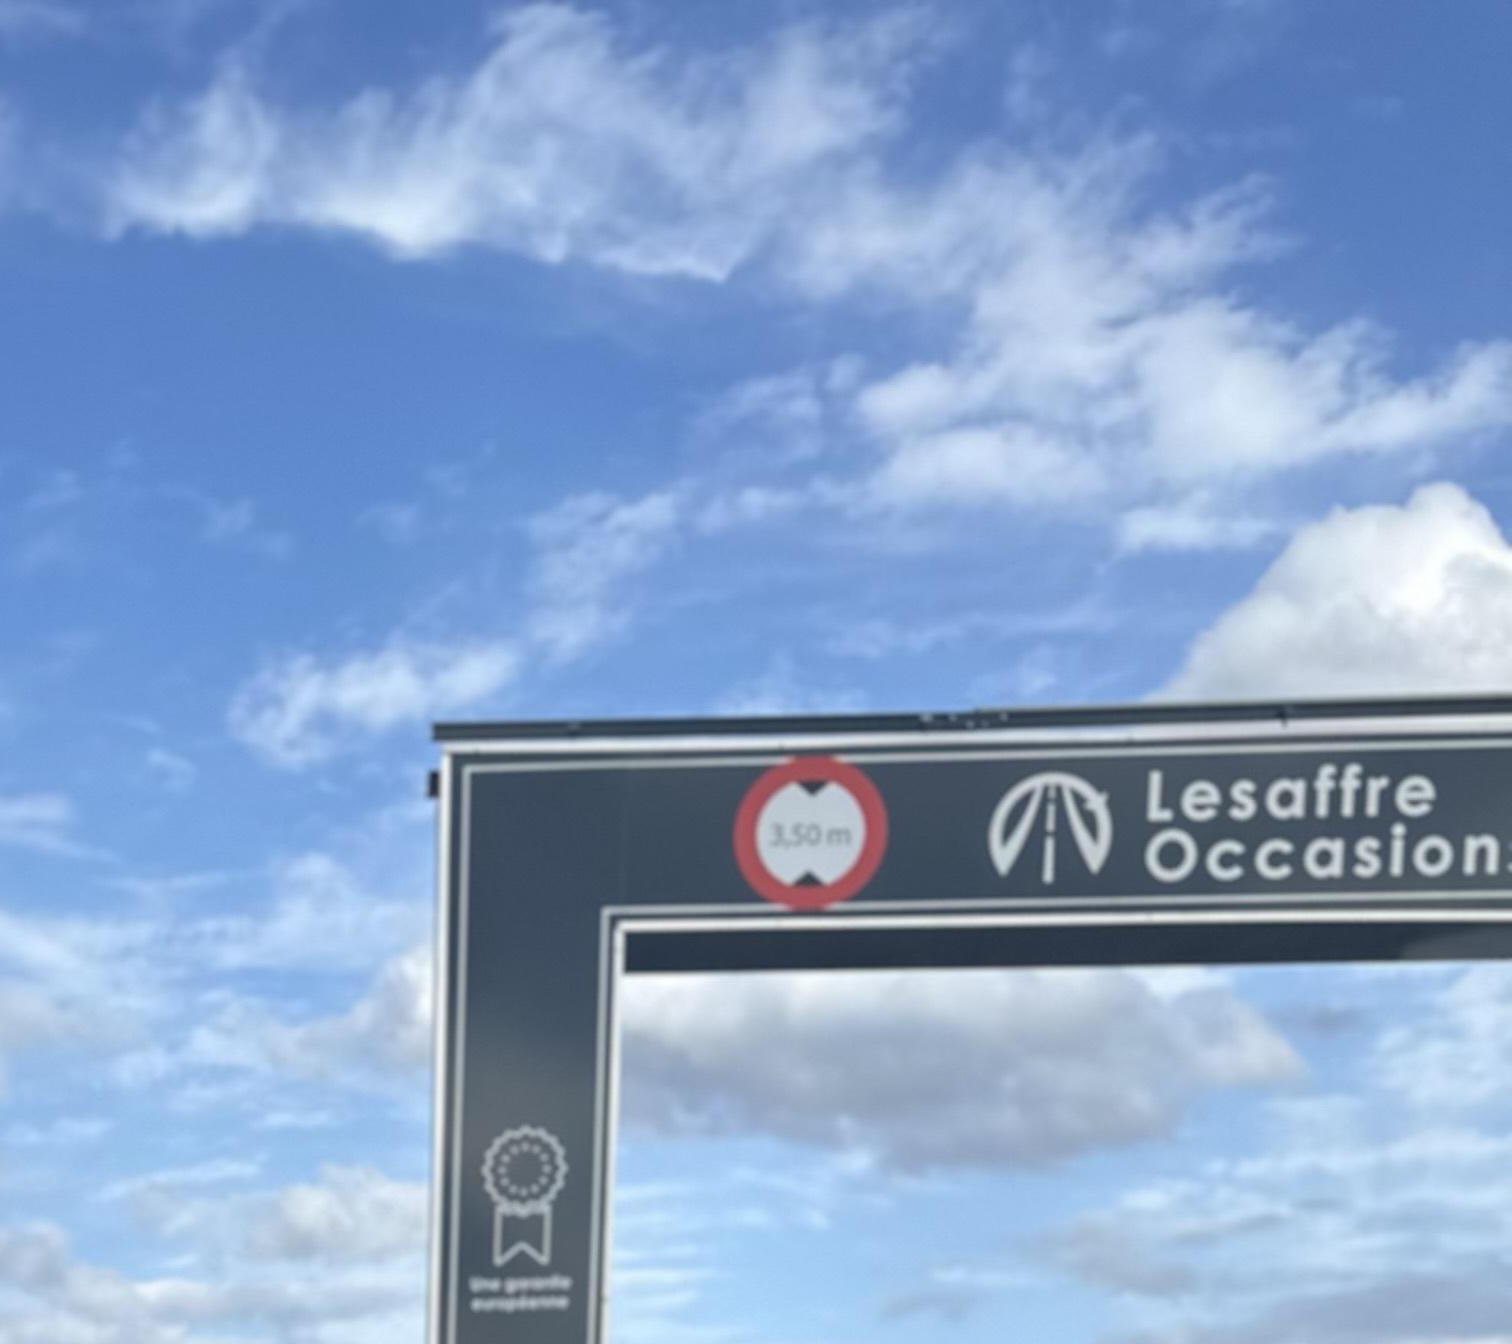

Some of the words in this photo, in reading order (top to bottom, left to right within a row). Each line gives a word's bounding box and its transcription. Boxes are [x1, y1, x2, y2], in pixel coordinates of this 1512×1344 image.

[1145, 762, 1437, 823] Lesaffre
[771, 822, 822, 849] 3,50
[826, 827, 852, 846] m
[1144, 823, 1512, 884] Occasion
